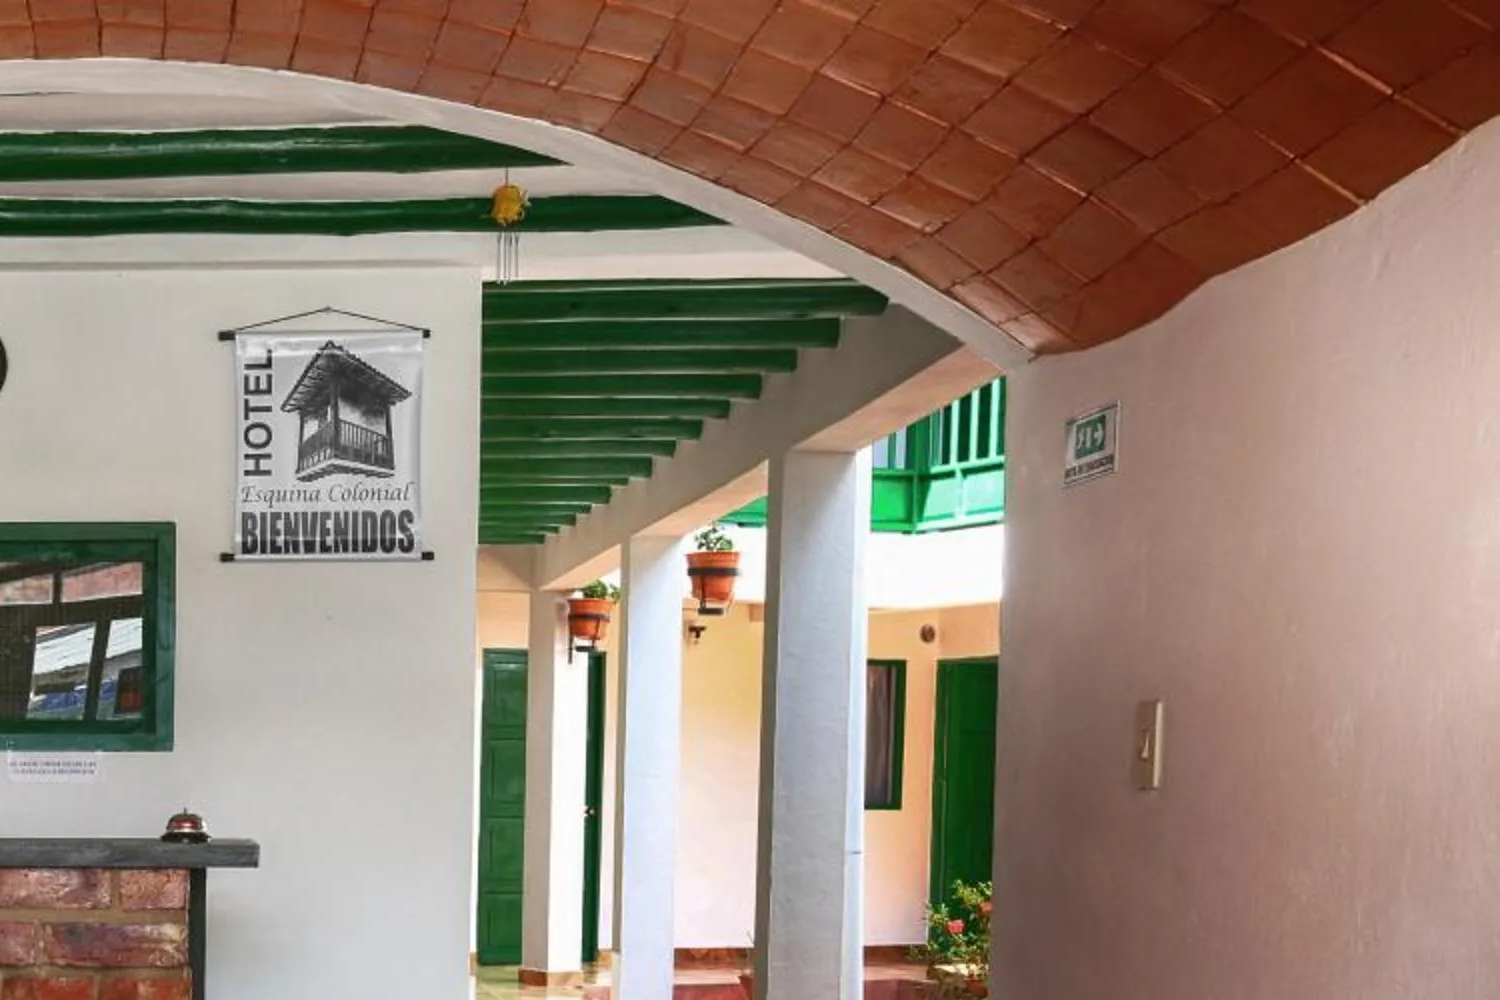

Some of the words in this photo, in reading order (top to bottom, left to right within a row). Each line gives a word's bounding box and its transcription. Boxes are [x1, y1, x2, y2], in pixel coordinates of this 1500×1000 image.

[243, 349, 273, 477] HOTEL
[240, 484, 321, 508] Esquina
[327, 481, 415, 503] Colonial
[241, 509, 415, 555] BIENVENIDOS
